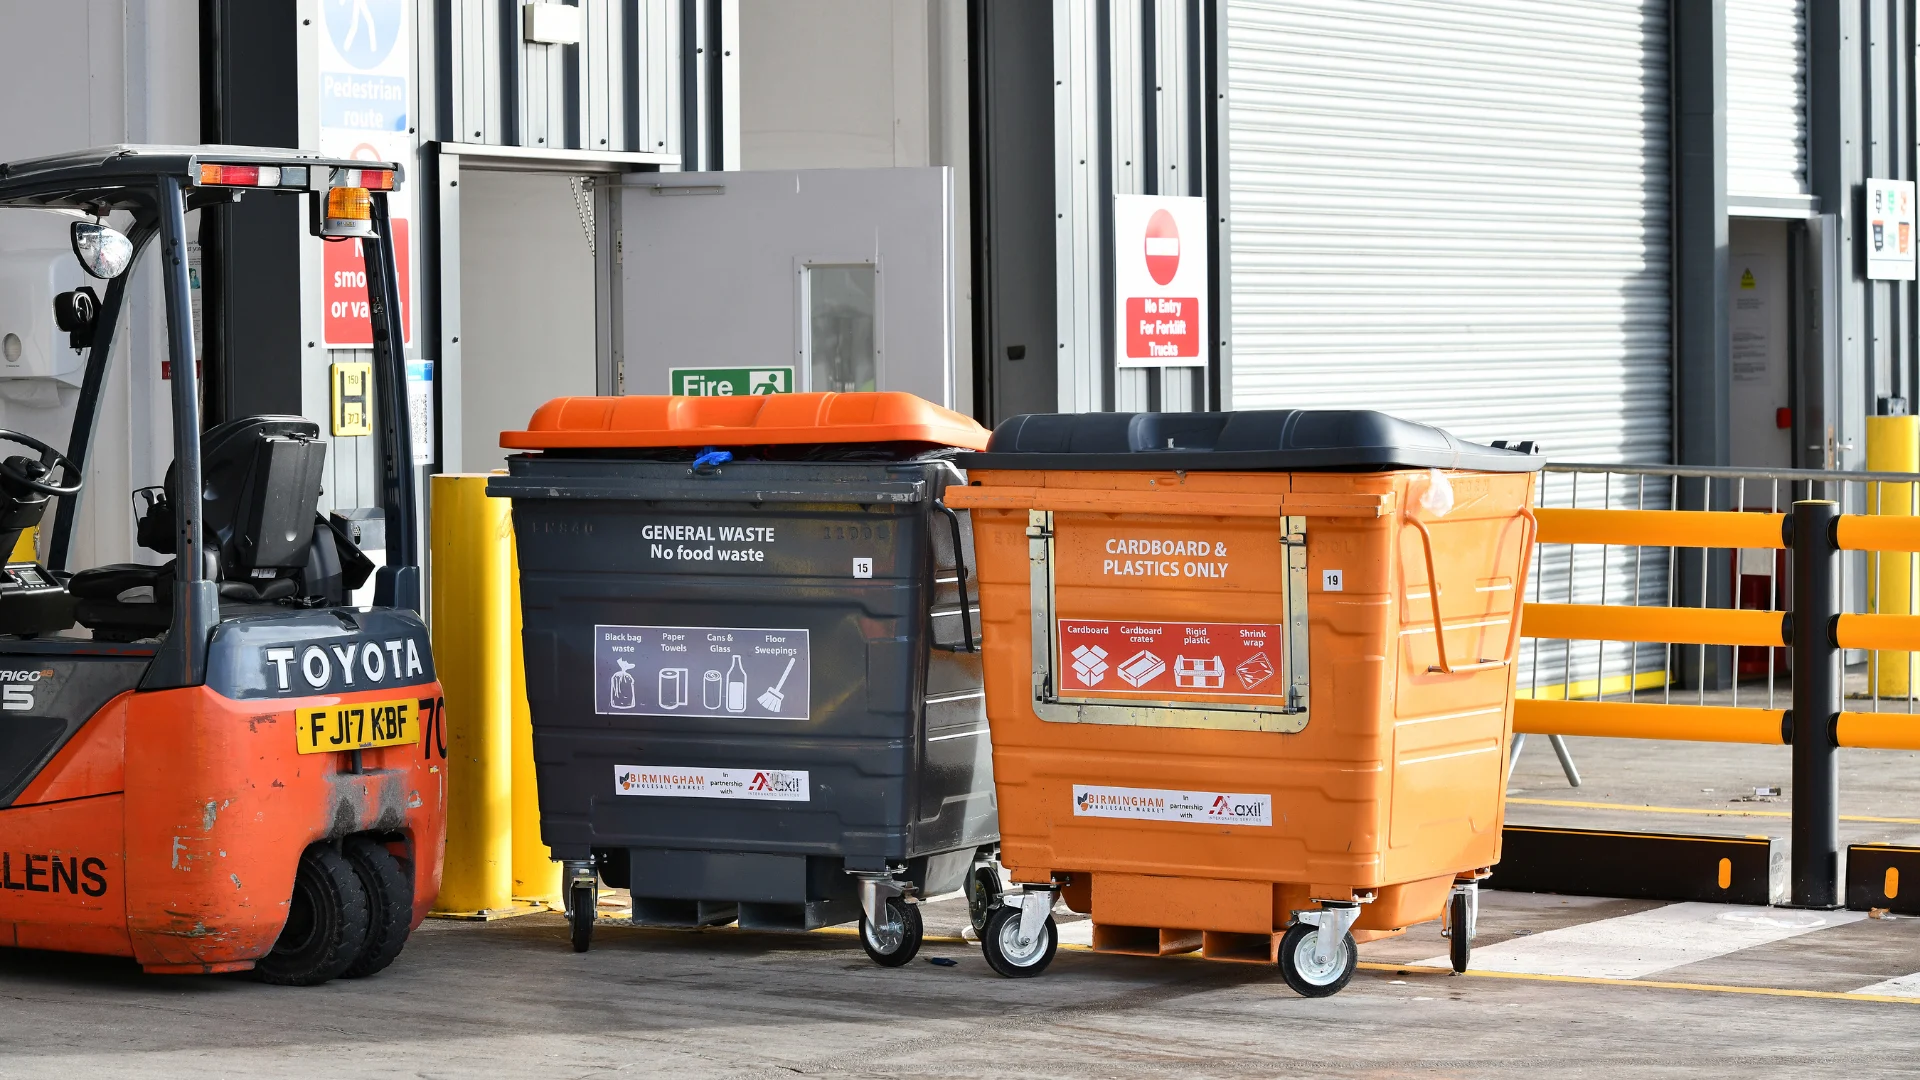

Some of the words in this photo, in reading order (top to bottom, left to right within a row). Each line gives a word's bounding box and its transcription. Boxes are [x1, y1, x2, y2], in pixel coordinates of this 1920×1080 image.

[324, 75, 402, 100] Pedestrian
[344, 109, 384, 128] route
[331, 301, 348, 318] or
[1144, 298, 1157, 313] No
[1158, 298, 1181, 317] Entry
[1140, 320, 1155, 335] For
[1155, 320, 1187, 335] Forklift
[1148, 341, 1179, 357] Trucks
[683, 375, 733, 396] Fire
[641, 525, 715, 541] GENERAL
[719, 526, 775, 542] WASTE
[650, 543, 674, 560] No
[677, 544, 714, 561] food
[717, 548, 765, 562] waste
[1105, 538, 1211, 557] CARDBOARD
[1214, 541, 1228, 557] &
[857, 563, 868, 573] 15
[1103, 559, 1180, 577] PLASTICS
[1183, 561, 1229, 578] ONLY
[1327, 575, 1339, 586] 19
[1067, 625, 1109, 634] Cardboard
[1120, 625, 1162, 635] Cardboard
[1185, 627, 1207, 637] Rigid
[1239, 629, 1267, 638] Shrink
[604, 632, 626, 641] Black
[626, 633, 642, 643] bag
[662, 632, 685, 642] Paper
[706, 633, 725, 642] Cans
[726, 633, 734, 642] &
[765, 634, 786, 643] Floor
[1129, 635, 1154, 643] crates
[1183, 635, 1211, 645] plastic
[660, 643, 687, 652] Towels
[709, 644, 731, 653] Glass
[1243, 640, 1264, 648] wrap
[754, 646, 798, 657] Sweepings
[266, 638, 424, 690] TOYOTA
[310, 709, 365, 747] FJ17
[370, 704, 408, 741] KBF
[630, 773, 705, 785] BIRMINGHAM
[710, 779, 743, 788] partnership
[1088, 793, 1164, 808] BIRMINGHAM
[1089, 804, 1132, 812] WHOLESALE
[1169, 803, 1204, 811] partnership
[1234, 802, 1262, 817] axil
[0, 852, 108, 897] LENS
